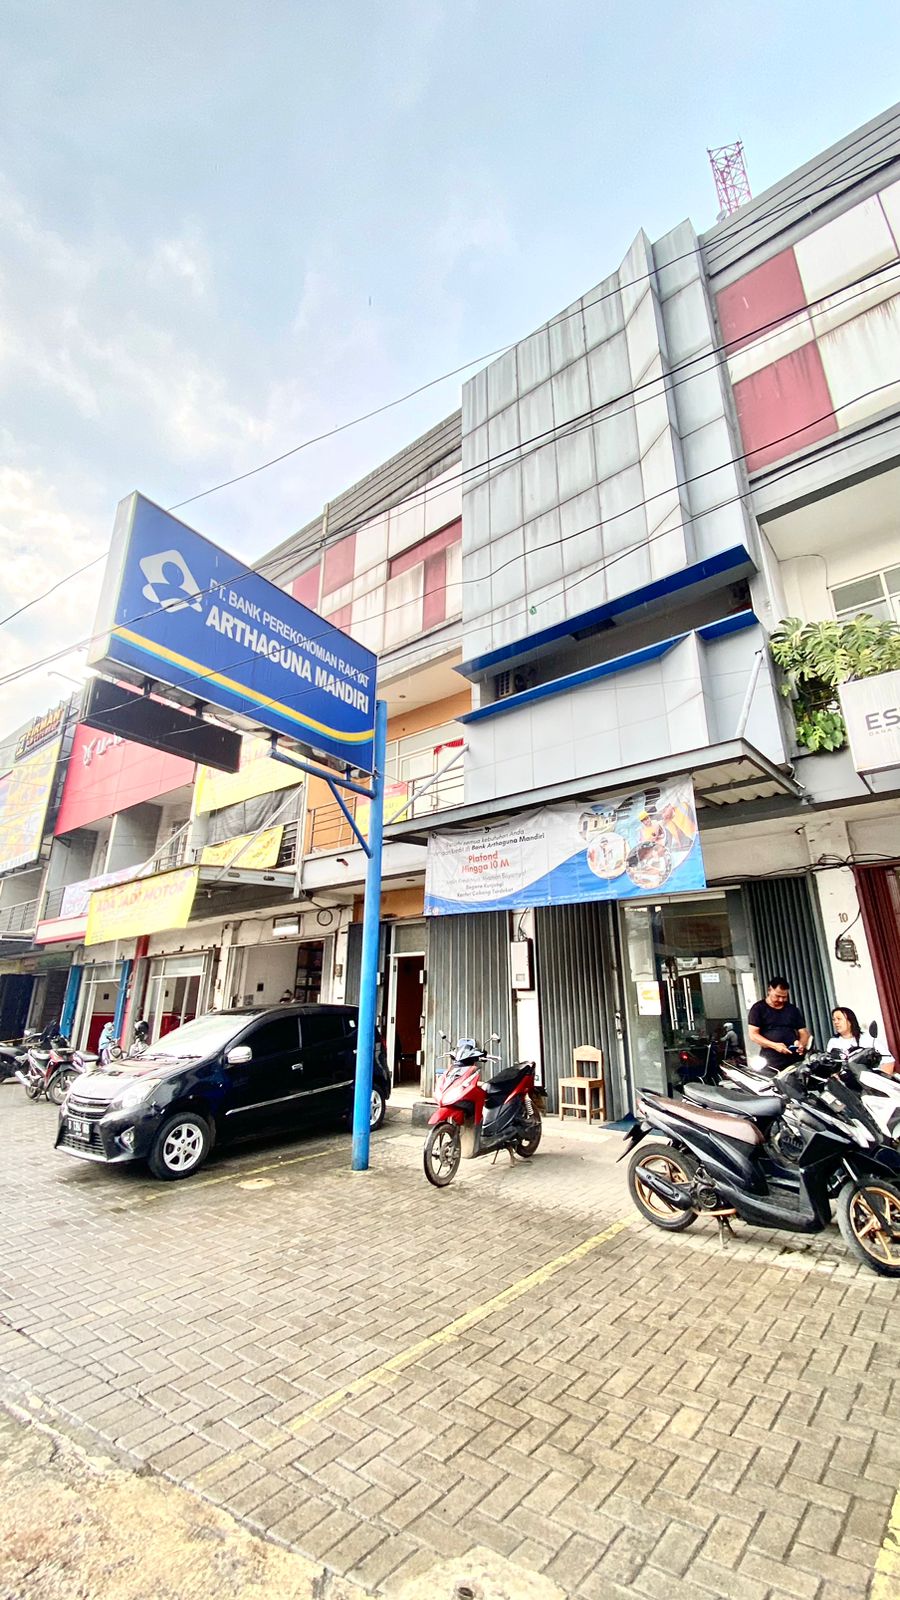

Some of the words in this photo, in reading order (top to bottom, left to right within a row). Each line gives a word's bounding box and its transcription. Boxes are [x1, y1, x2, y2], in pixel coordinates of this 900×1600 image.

[209, 578, 226, 602] PT.
[228, 590, 261, 623] BANK
[262, 611, 338, 668] PEREKONOMIAN
[338, 659, 370, 688] RAKYAT
[205, 605, 312, 682] ARTHAGUNA
[315, 665, 369, 715] MANDIRI
[865, 708, 900, 731] ES
[486, 838, 518, 849] Arthaguna
[519, 833, 545, 843] Mandiri
[509, 829, 524, 837] Anda
[468, 850, 498, 863] Plafond
[461, 864, 489, 875] Hingga
[490, 860, 498, 869] 10
[500, 859, 510, 868] M
[838, 912, 848, 923] 10
